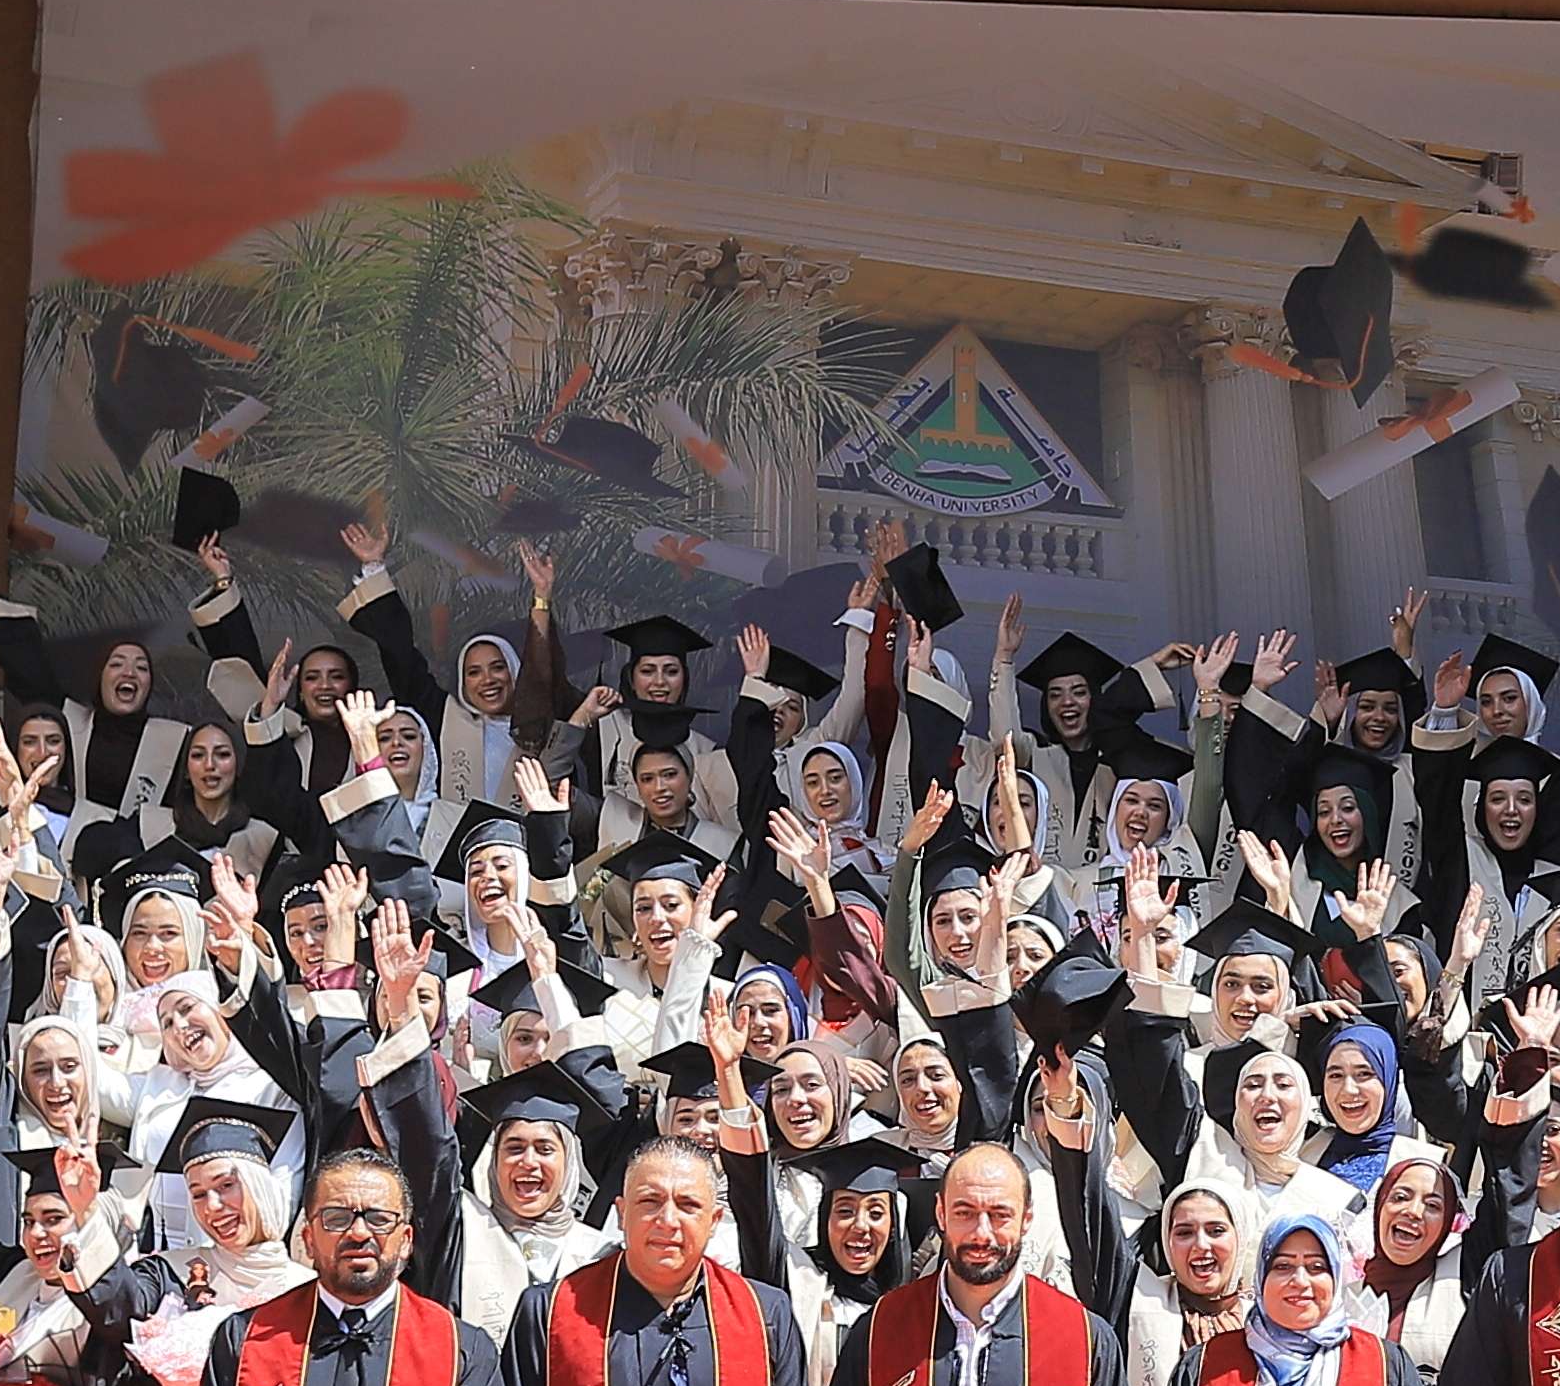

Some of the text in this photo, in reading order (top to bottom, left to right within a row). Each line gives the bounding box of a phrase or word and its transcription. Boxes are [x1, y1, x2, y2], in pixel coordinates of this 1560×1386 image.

[882, 472, 1040, 513] BENHA UNIVERSITY
[1399, 840, 1415, 890] 202
